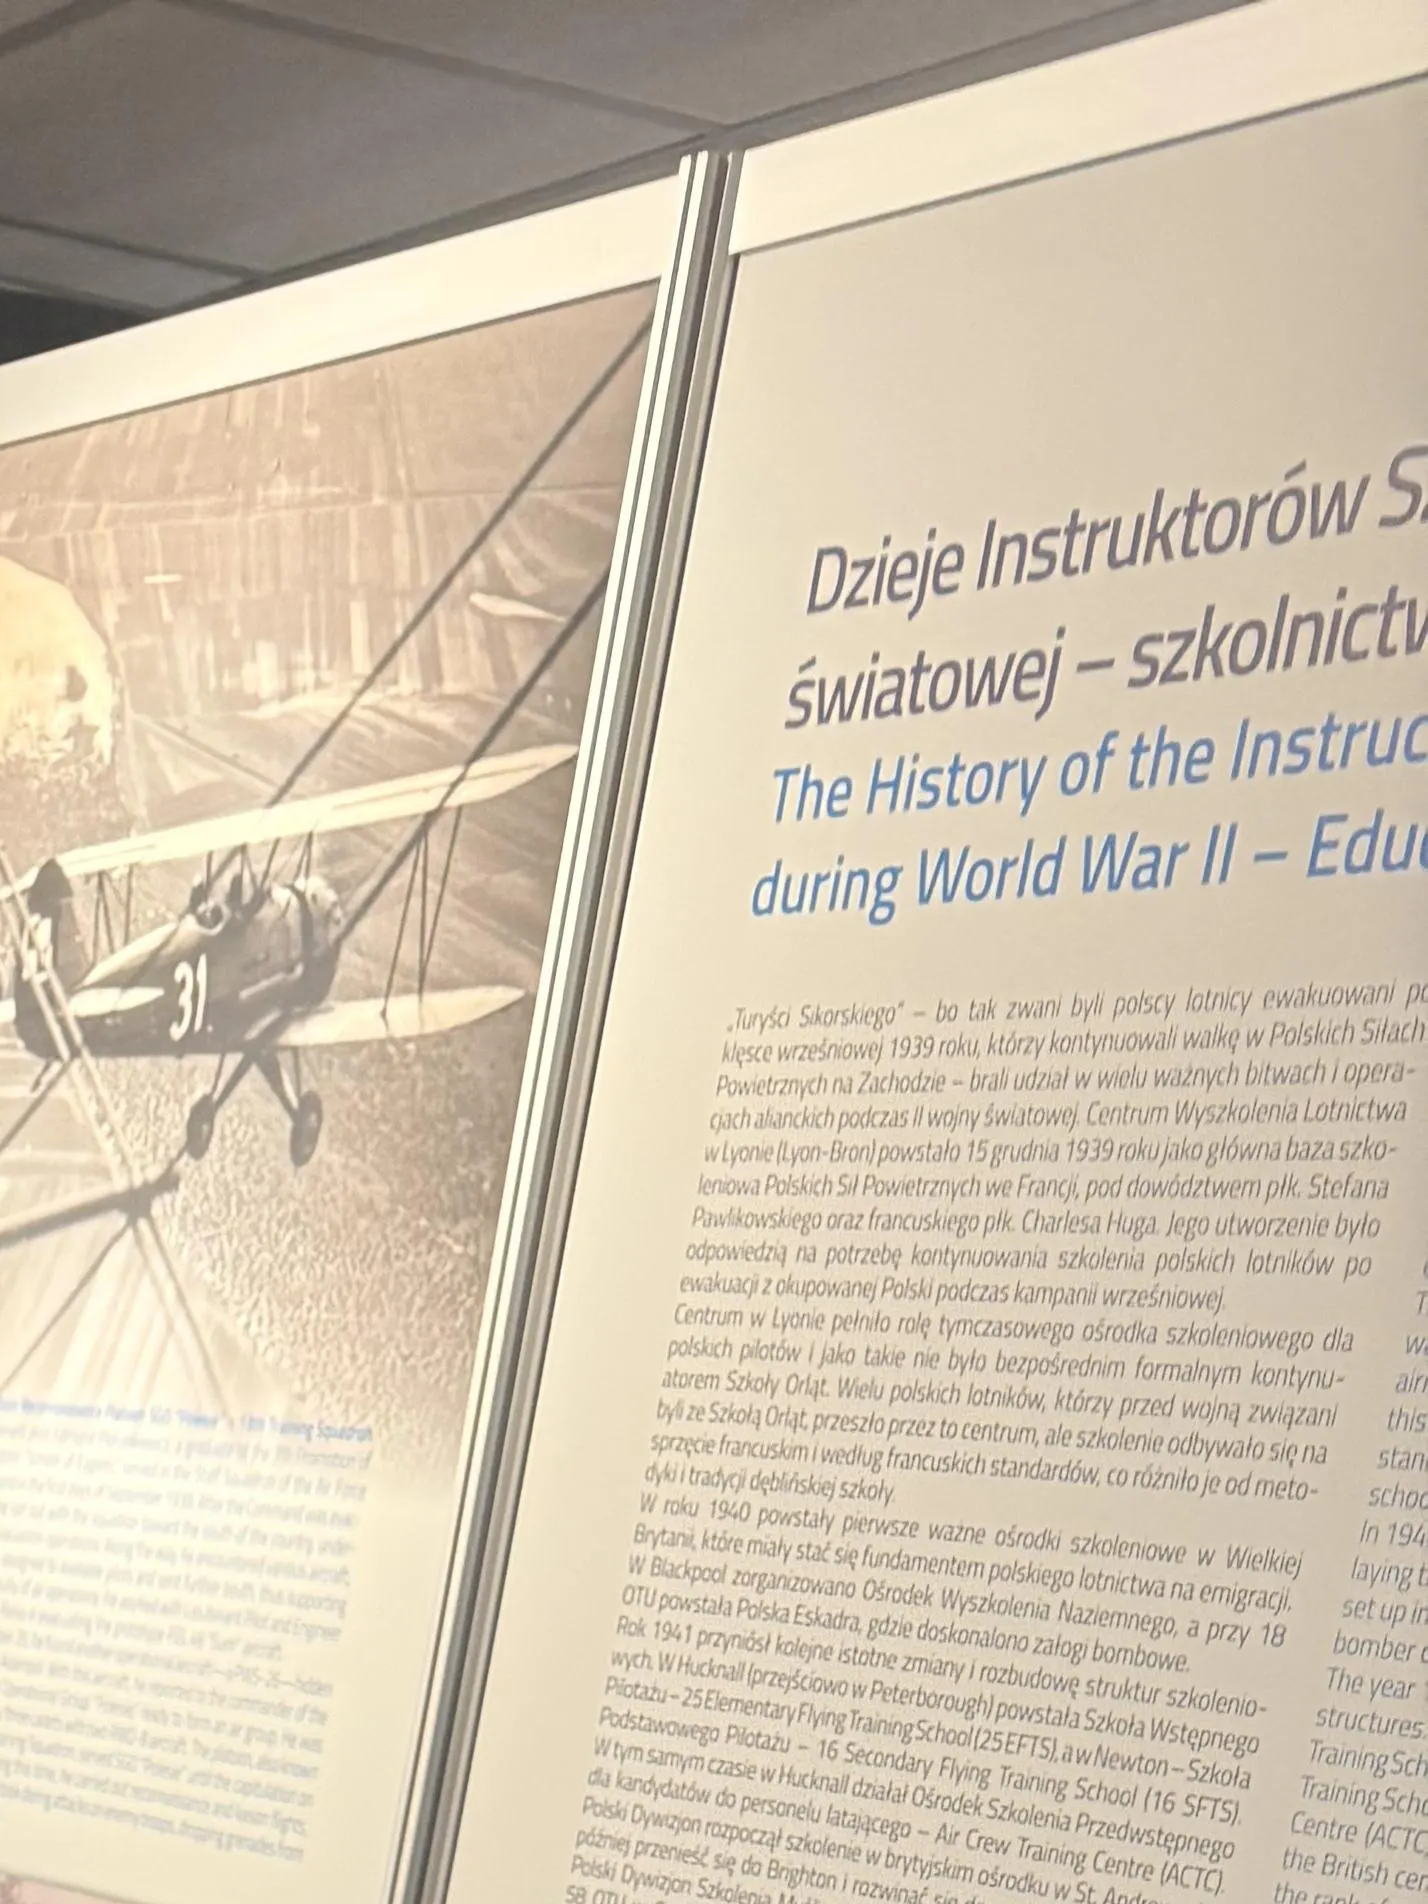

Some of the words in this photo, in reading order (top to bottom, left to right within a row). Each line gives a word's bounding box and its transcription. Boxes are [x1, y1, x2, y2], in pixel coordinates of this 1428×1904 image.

[806, 527, 965, 622] Dzieje
[976, 460, 1371, 591] Instruktorów
[1379, 445, 1428, 528] S
[784, 626, 1066, 730] światowej
[775, 763, 853, 823] The
[866, 752, 1048, 818] History
[1060, 730, 1120, 797] of
[1129, 724, 1215, 791] the
[751, 854, 904, 926] during
[918, 835, 1067, 906] World
[1082, 831, 1190, 894] War
[1201, 823, 1238, 885] II
[1306, 809, 1428, 878] Edu
[170, 954, 208, 1041] 31
[935, 998, 959, 1024] bo
[968, 996, 998, 1022] tak
[1005, 994, 1063, 1020] zwani
[1070, 991, 1105, 1024] byli
[1111, 989, 1177, 1023] polscy
[1185, 986, 1253, 1017] lotnicy
[1263, 982, 1396, 1010] ewakuowani
[691, 1205, 823, 1237] Pawlikowskiego
[826, 1212, 865, 1231] oraz
[867, 1206, 980, 1240] francuskiego
[1021, 1208, 1102, 1235] Charlesa
[1165, 1210, 1210, 1243] Jego
[1214, 1211, 1330, 1238] utworzenie
[1334, 1211, 1381, 1245] było
[795, 1245, 817, 1264] na
[824, 1241, 903, 1272] potrzebę
[910, 1241, 1048, 1275] kontynuowania
[1057, 1244, 1145, 1272] szkolenia
[1153, 1246, 1235, 1278] polskich
[1245, 1247, 1335, 1276] lotników
[674, 1302, 744, 1327] Centrum
[771, 1306, 826, 1335] Lyonie
[830, 1308, 891, 1337] pełniło
[897, 1311, 932, 1341] rolę
[938, 1314, 1075, 1347] tymczasowego
[1082, 1317, 1158, 1345] ośrodka
[1165, 1320, 1314, 1358] szkoleniowego
[1322, 1326, 1354, 1353] dla
[640, 1492, 658, 1514] W
[662, 1495, 700, 1518] roku
[710, 1499, 752, 1523] 1940
[756, 1507, 836, 1536] powstały
[841, 1514, 920, 1539] pierwsze
[928, 1523, 987, 1545] ważne
[994, 1524, 1061, 1552] ośrodki
[1070, 1532, 1187, 1564] szkoleniowe
[1226, 1544, 1304, 1581] Wielkiej
[1359, 1519, 1380, 1545] In
[1388, 1521, 1428, 1548] 194
[1351, 1555, 1414, 1593] laying
[628, 1554, 647, 1576] W
[649, 1555, 728, 1587] Blackpool
[862, 1577, 935, 1608] Ośrodek
[941, 1586, 1051, 1622] Wyszkolenia
[1057, 1599, 1178, 1641] Naziemnego,
[1186, 1619, 1200, 1638] a
[1204, 1621, 1252, 1650] przy
[1262, 1622, 1288, 1648] 18
[1342, 1597, 1377, 1620] set
[1379, 1603, 1408, 1630] up
[1332, 1628, 1417, 1662] bomber
[1328, 1666, 1364, 1695] The
[1369, 1677, 1417, 1703] year
[598, 1705, 721, 1748] Podstawowego
[819, 1739, 839, 1762] 16
[843, 1741, 935, 1782] Secondary
[938, 1755, 992, 1792] Flying
[1000, 1764, 1069, 1804] Training
[1073, 1776, 1139, 1808] School
[1143, 1786, 1177, 1815] (16
[1310, 1738, 1390, 1780] Training
[1301, 1774, 1381, 1816] Training
[1290, 1810, 1358, 1843] Centre
[1282, 1847, 1317, 1874] the
[1320, 1852, 1389, 1886] British
